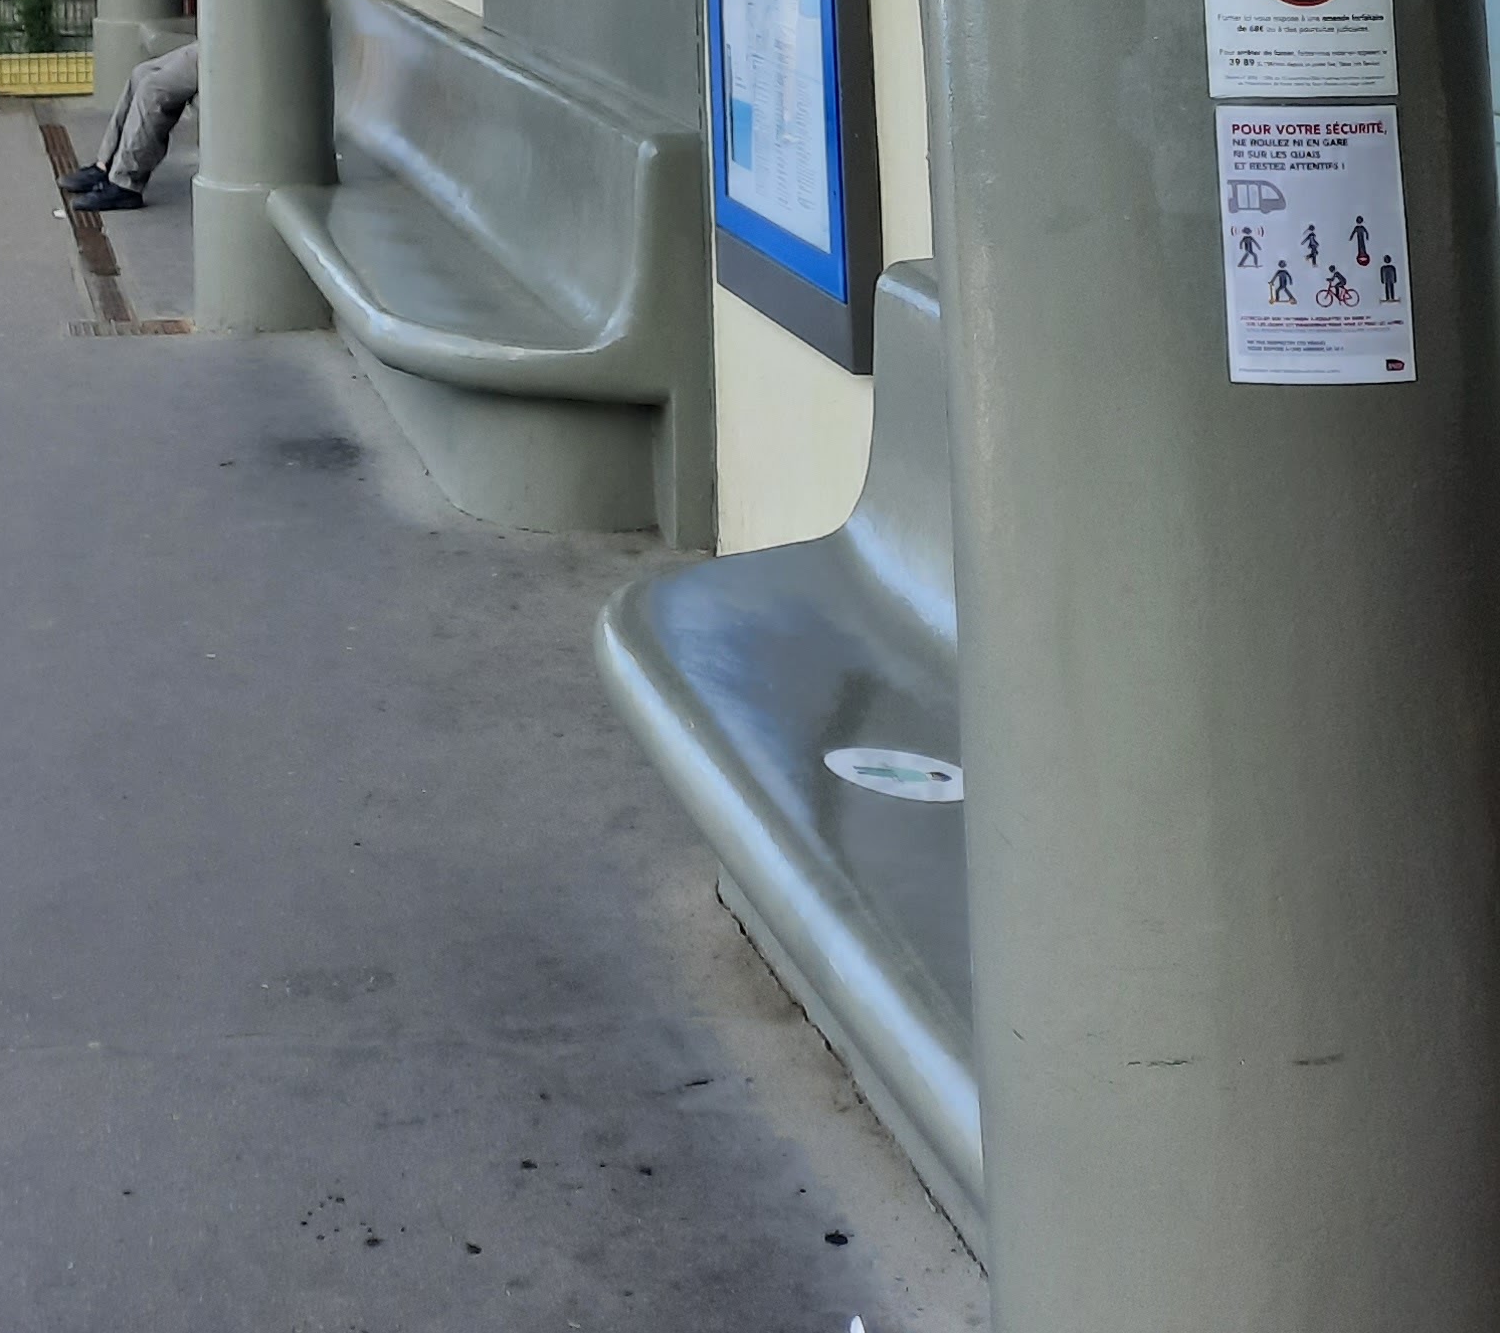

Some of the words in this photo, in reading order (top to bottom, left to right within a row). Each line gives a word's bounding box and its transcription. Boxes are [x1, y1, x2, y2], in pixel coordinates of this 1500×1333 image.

[1230, 123, 1272, 136] POUR
[1275, 123, 1321, 136] VOTRE
[1231, 138, 1247, 147] NE
[1250, 138, 1290, 148] ROULEZ
[1306, 138, 1320, 148] EN
[1322, 138, 1349, 147] GARE
[1247, 150, 1267, 159] SUR
[1270, 150, 1288, 159] LES
